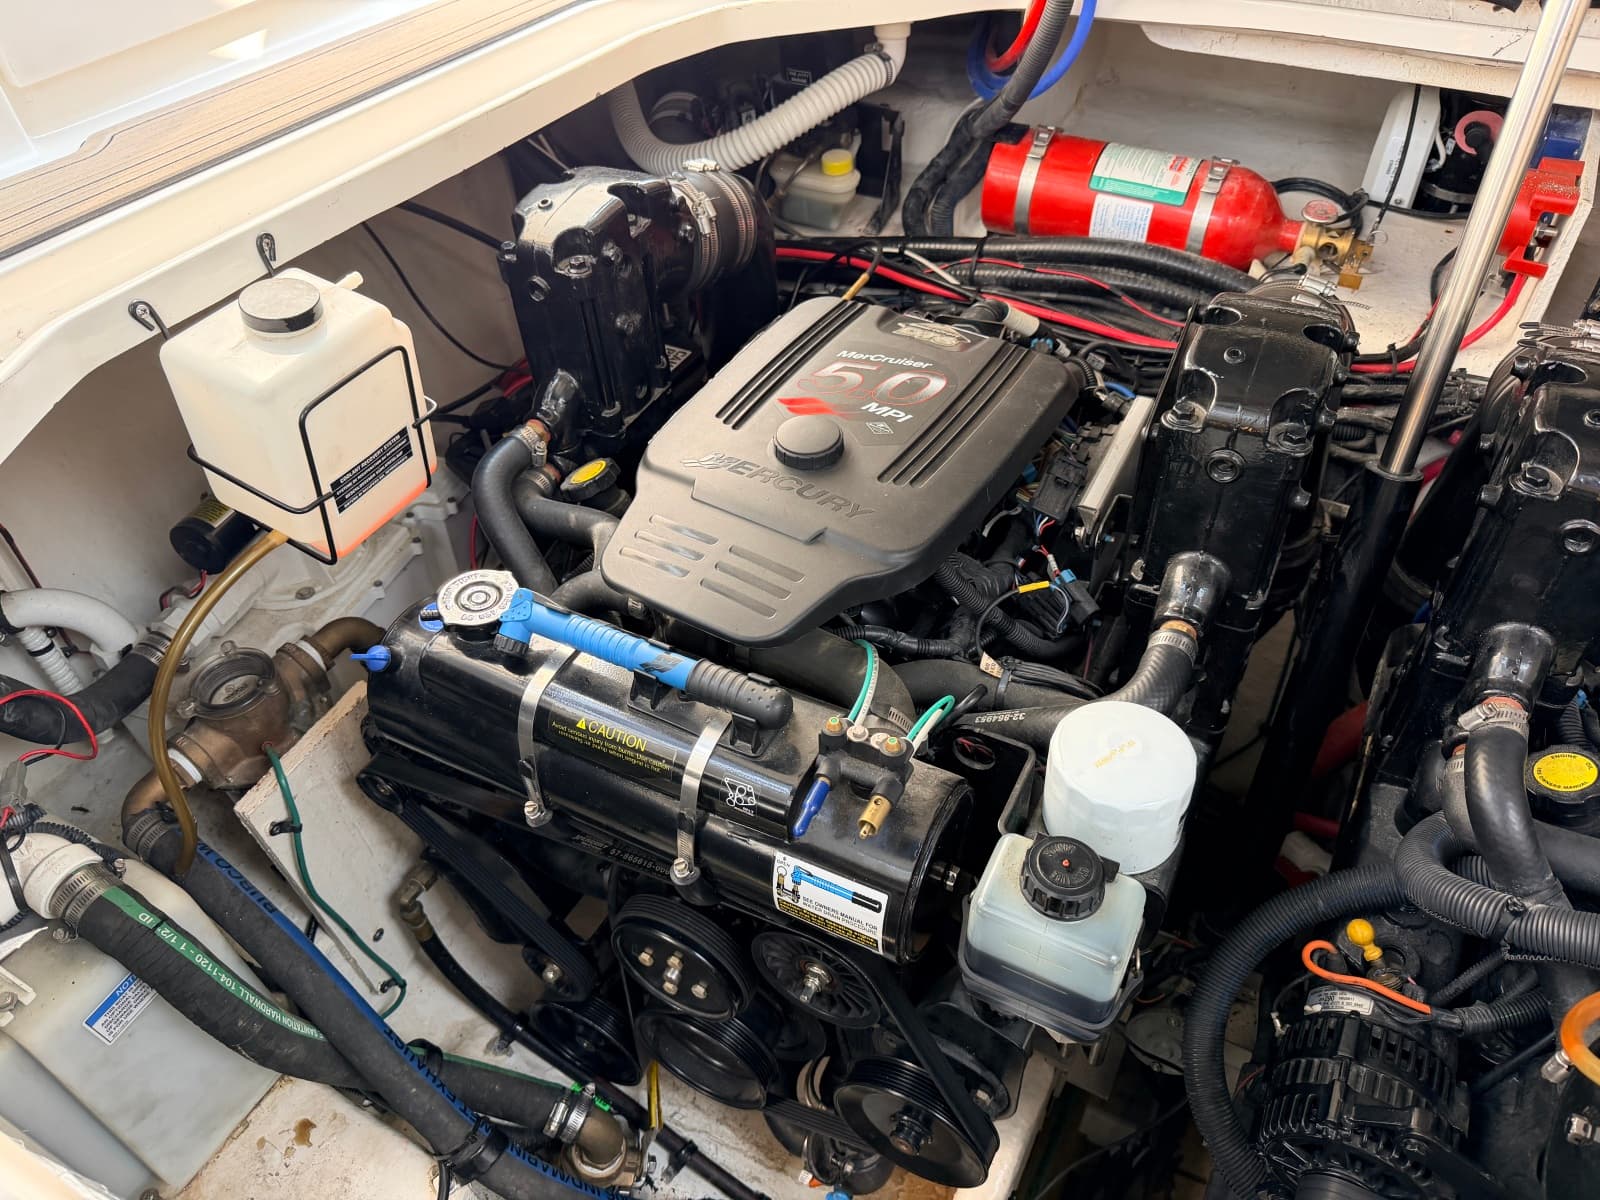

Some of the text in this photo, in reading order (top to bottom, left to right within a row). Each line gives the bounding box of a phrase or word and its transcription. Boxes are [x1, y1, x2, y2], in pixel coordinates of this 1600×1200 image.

[837, 350, 933, 369] MerCruiser
[797, 360, 947, 406] 5.0
[860, 402, 913, 423] MPI
[339, 464, 360, 483] COOLANT
[360, 447, 383, 467] RECOVERY
[383, 434, 400, 449] SYSTEM
[681, 452, 875, 518] MERCURY
[588, 720, 648, 752] CAUTION
[839, 912, 864, 925] MANUAL
[195, 954, 236, 990] 104-1120
[108, 995, 131, 1019] OPTIONAL
[239, 986, 282, 1022] HARDWALL
